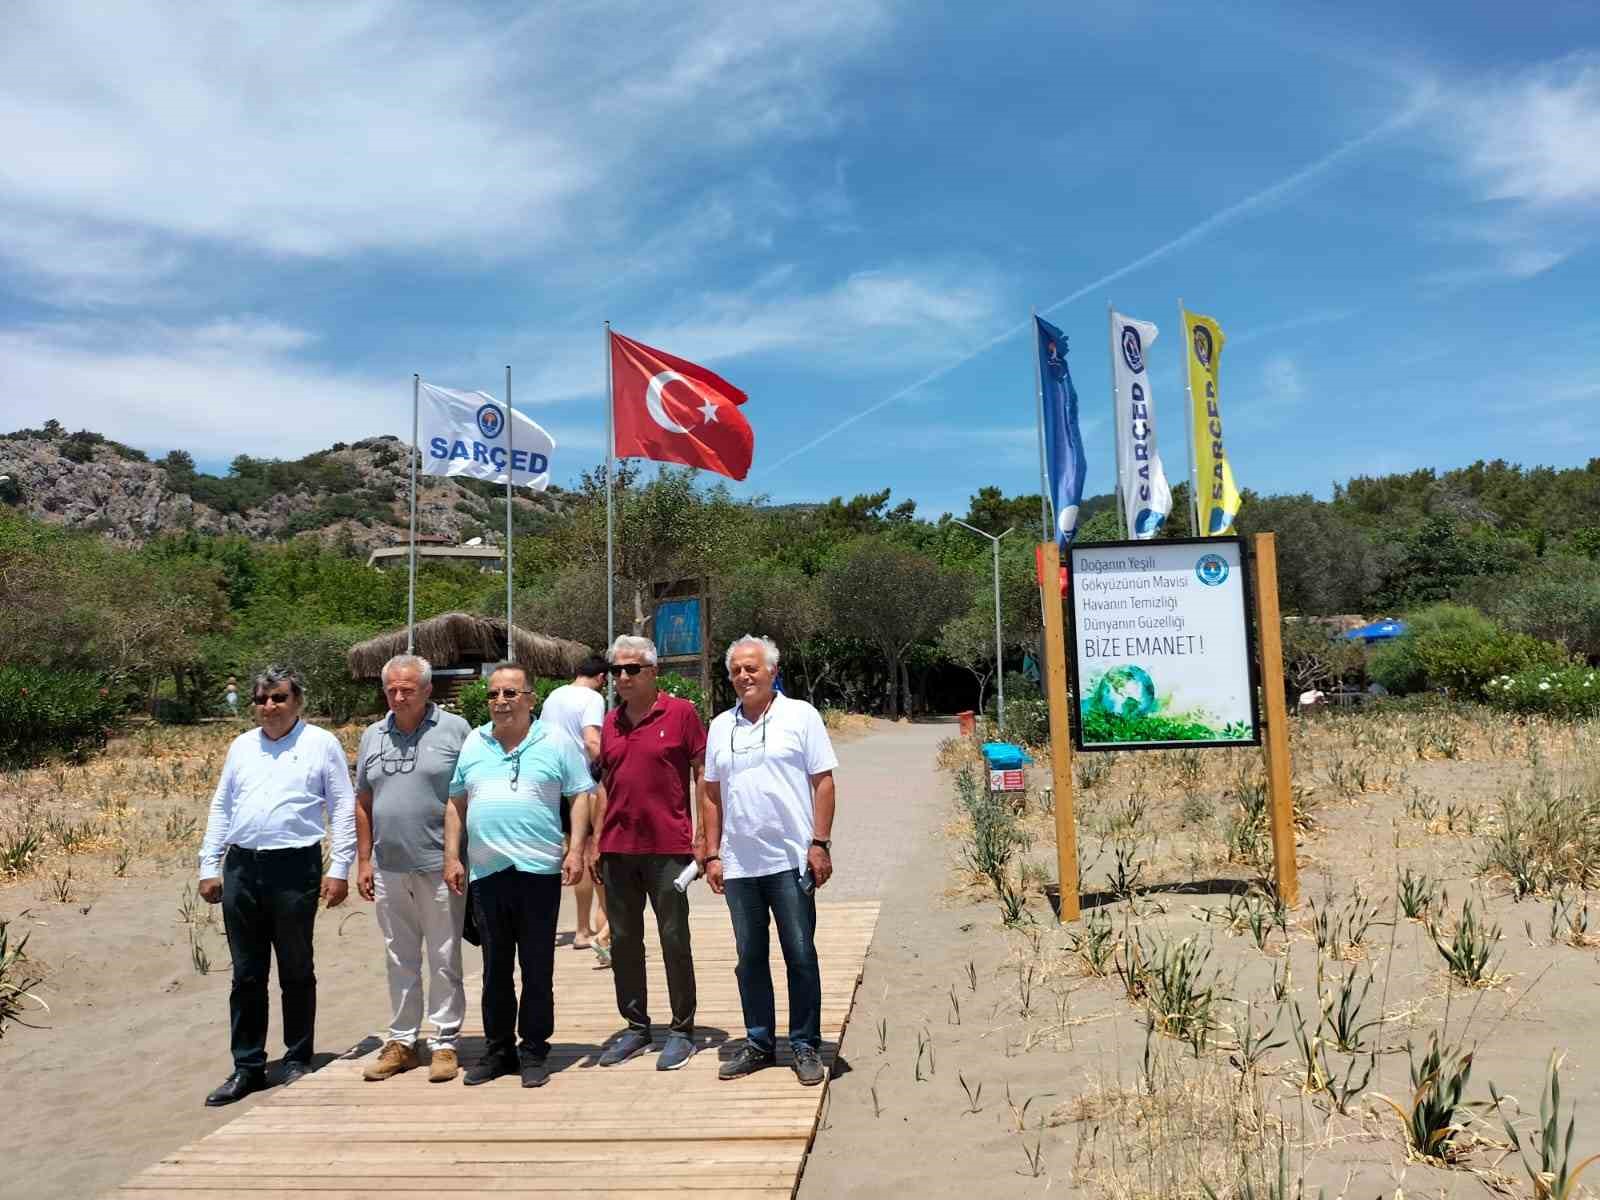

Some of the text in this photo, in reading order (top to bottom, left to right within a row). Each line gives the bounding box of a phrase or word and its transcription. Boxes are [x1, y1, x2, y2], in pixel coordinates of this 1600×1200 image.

[1130, 382, 1151, 501] SARÇED
[430, 437, 548, 474] SARÇED
[1080, 556, 1156, 574] Doğanın Yeşili
[1082, 575, 1188, 593] Gökyüzünün Mavisi
[1083, 596, 1178, 612] Havanın Temizliği
[1084, 615, 1185, 633] Dünyanın Güzelliği
[1085, 636, 1121, 657] BİZE
[1126, 635, 1196, 656] EMANET
